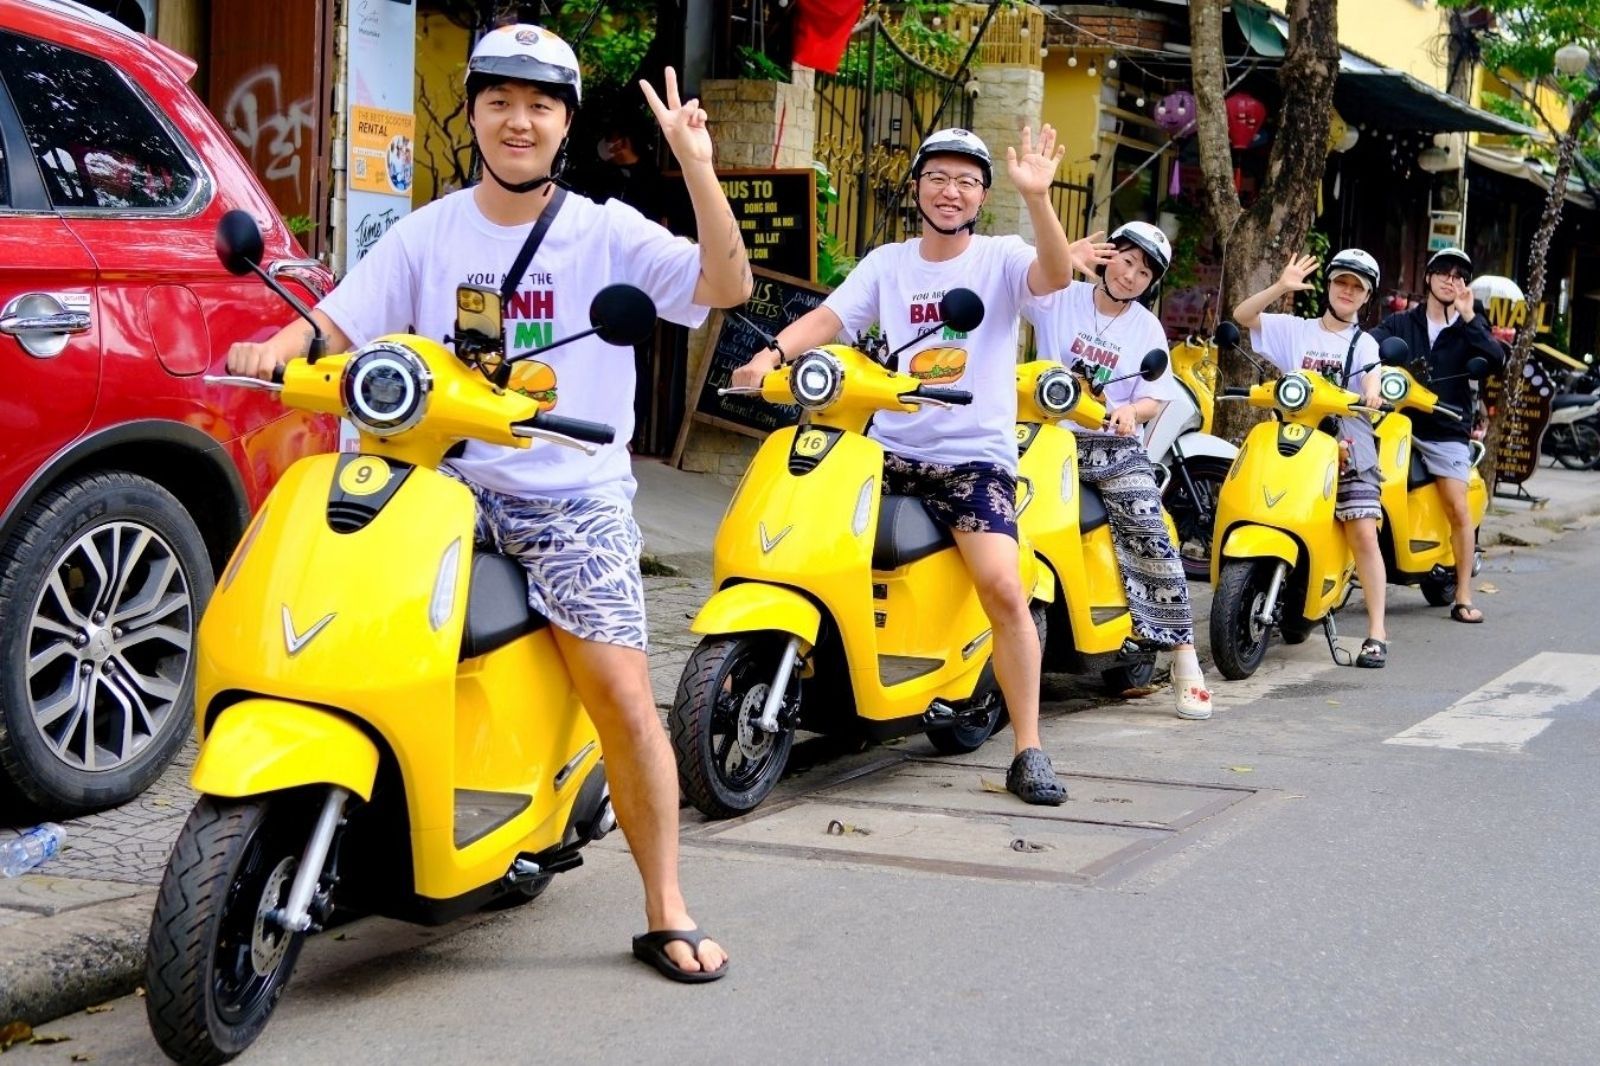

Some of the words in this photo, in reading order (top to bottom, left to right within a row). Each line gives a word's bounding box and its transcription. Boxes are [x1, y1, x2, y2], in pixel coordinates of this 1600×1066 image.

[358, 121, 388, 137] RENTAL
[751, 181, 773, 199] TO
[355, 213, 382, 246] Time
[754, 233, 765, 243] DA
[766, 232, 780, 243] LAT
[467, 273, 495, 285] YOU
[529, 273, 554, 285] THE
[910, 302, 945, 324] BA
[1488, 296, 1551, 334] NAL
[513, 321, 553, 350] MI
[1070, 336, 1121, 370] BANH
[1288, 427, 1301, 437] 11
[803, 436, 823, 450] 16
[355, 466, 373, 484] 9
